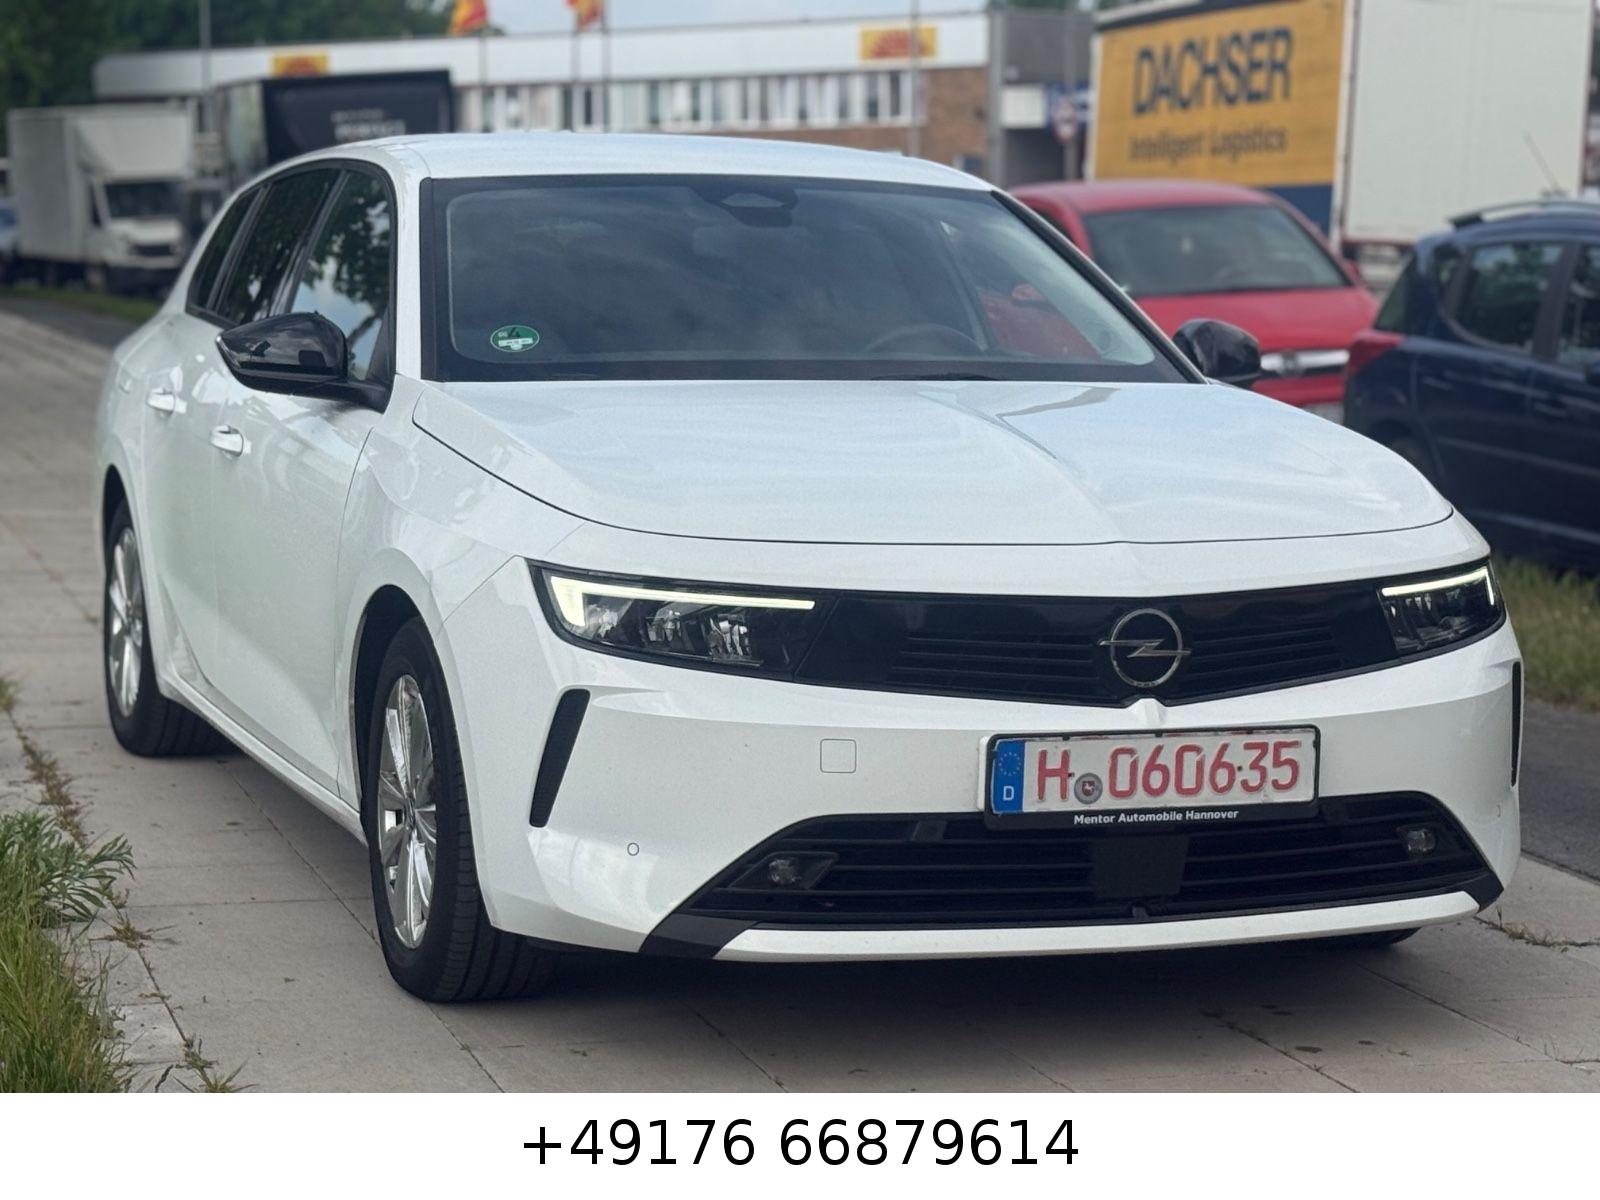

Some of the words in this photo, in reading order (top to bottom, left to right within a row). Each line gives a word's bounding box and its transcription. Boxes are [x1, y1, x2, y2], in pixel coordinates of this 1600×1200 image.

[1134, 28, 1292, 114] DACHSER
[1210, 126, 1287, 161] Logistics
[1037, 749, 1071, 801] H
[1108, 740, 1301, 799] 060635
[1002, 785, 1014, 801] D
[1073, 813, 1116, 825] Mentor
[1118, 811, 1183, 823] Automobile
[1185, 808, 1239, 821] Hannover
